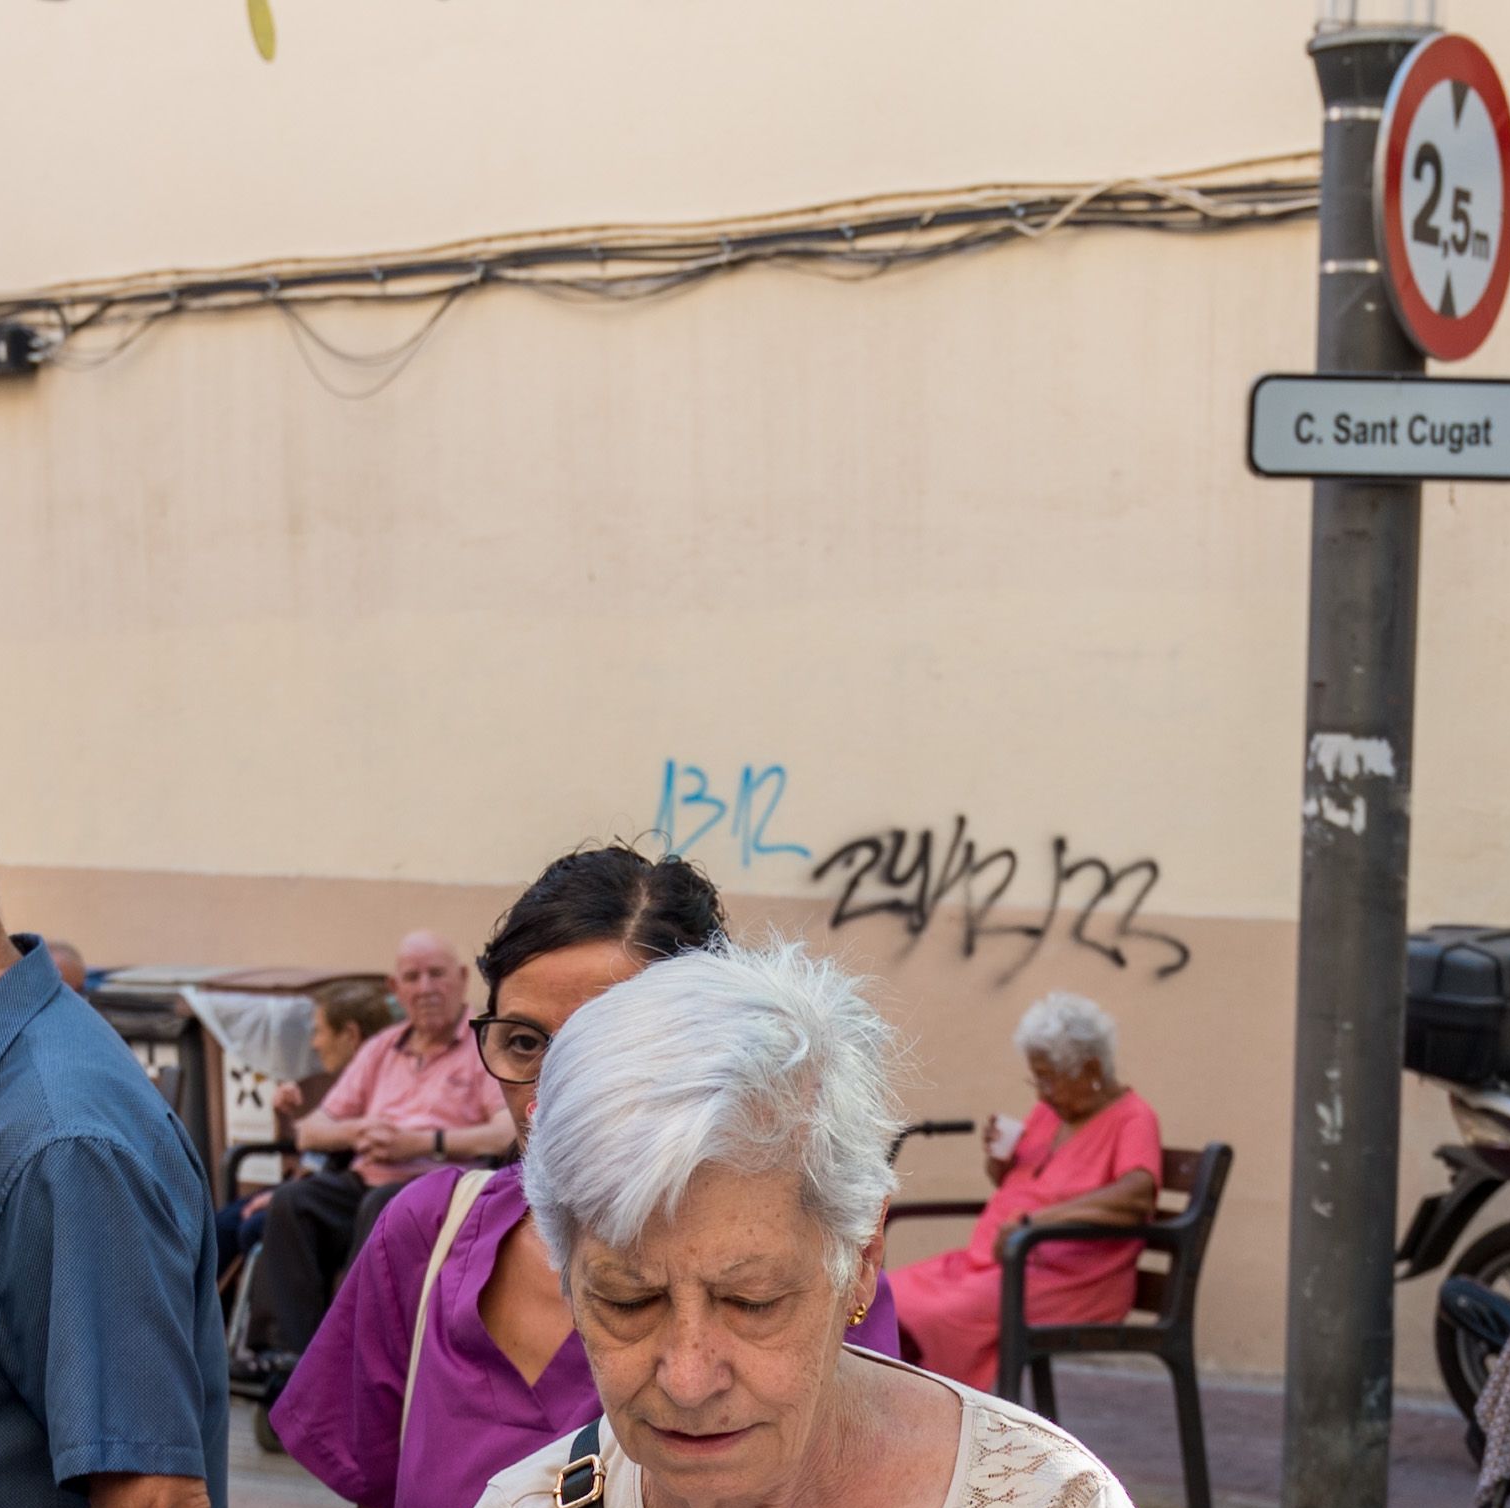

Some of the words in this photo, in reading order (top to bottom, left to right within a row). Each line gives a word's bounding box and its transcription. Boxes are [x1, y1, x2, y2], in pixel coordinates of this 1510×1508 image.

[1294, 412, 1323, 445] C.
[1333, 412, 1398, 446] Sant
[1407, 414, 1493, 454] Cugat
